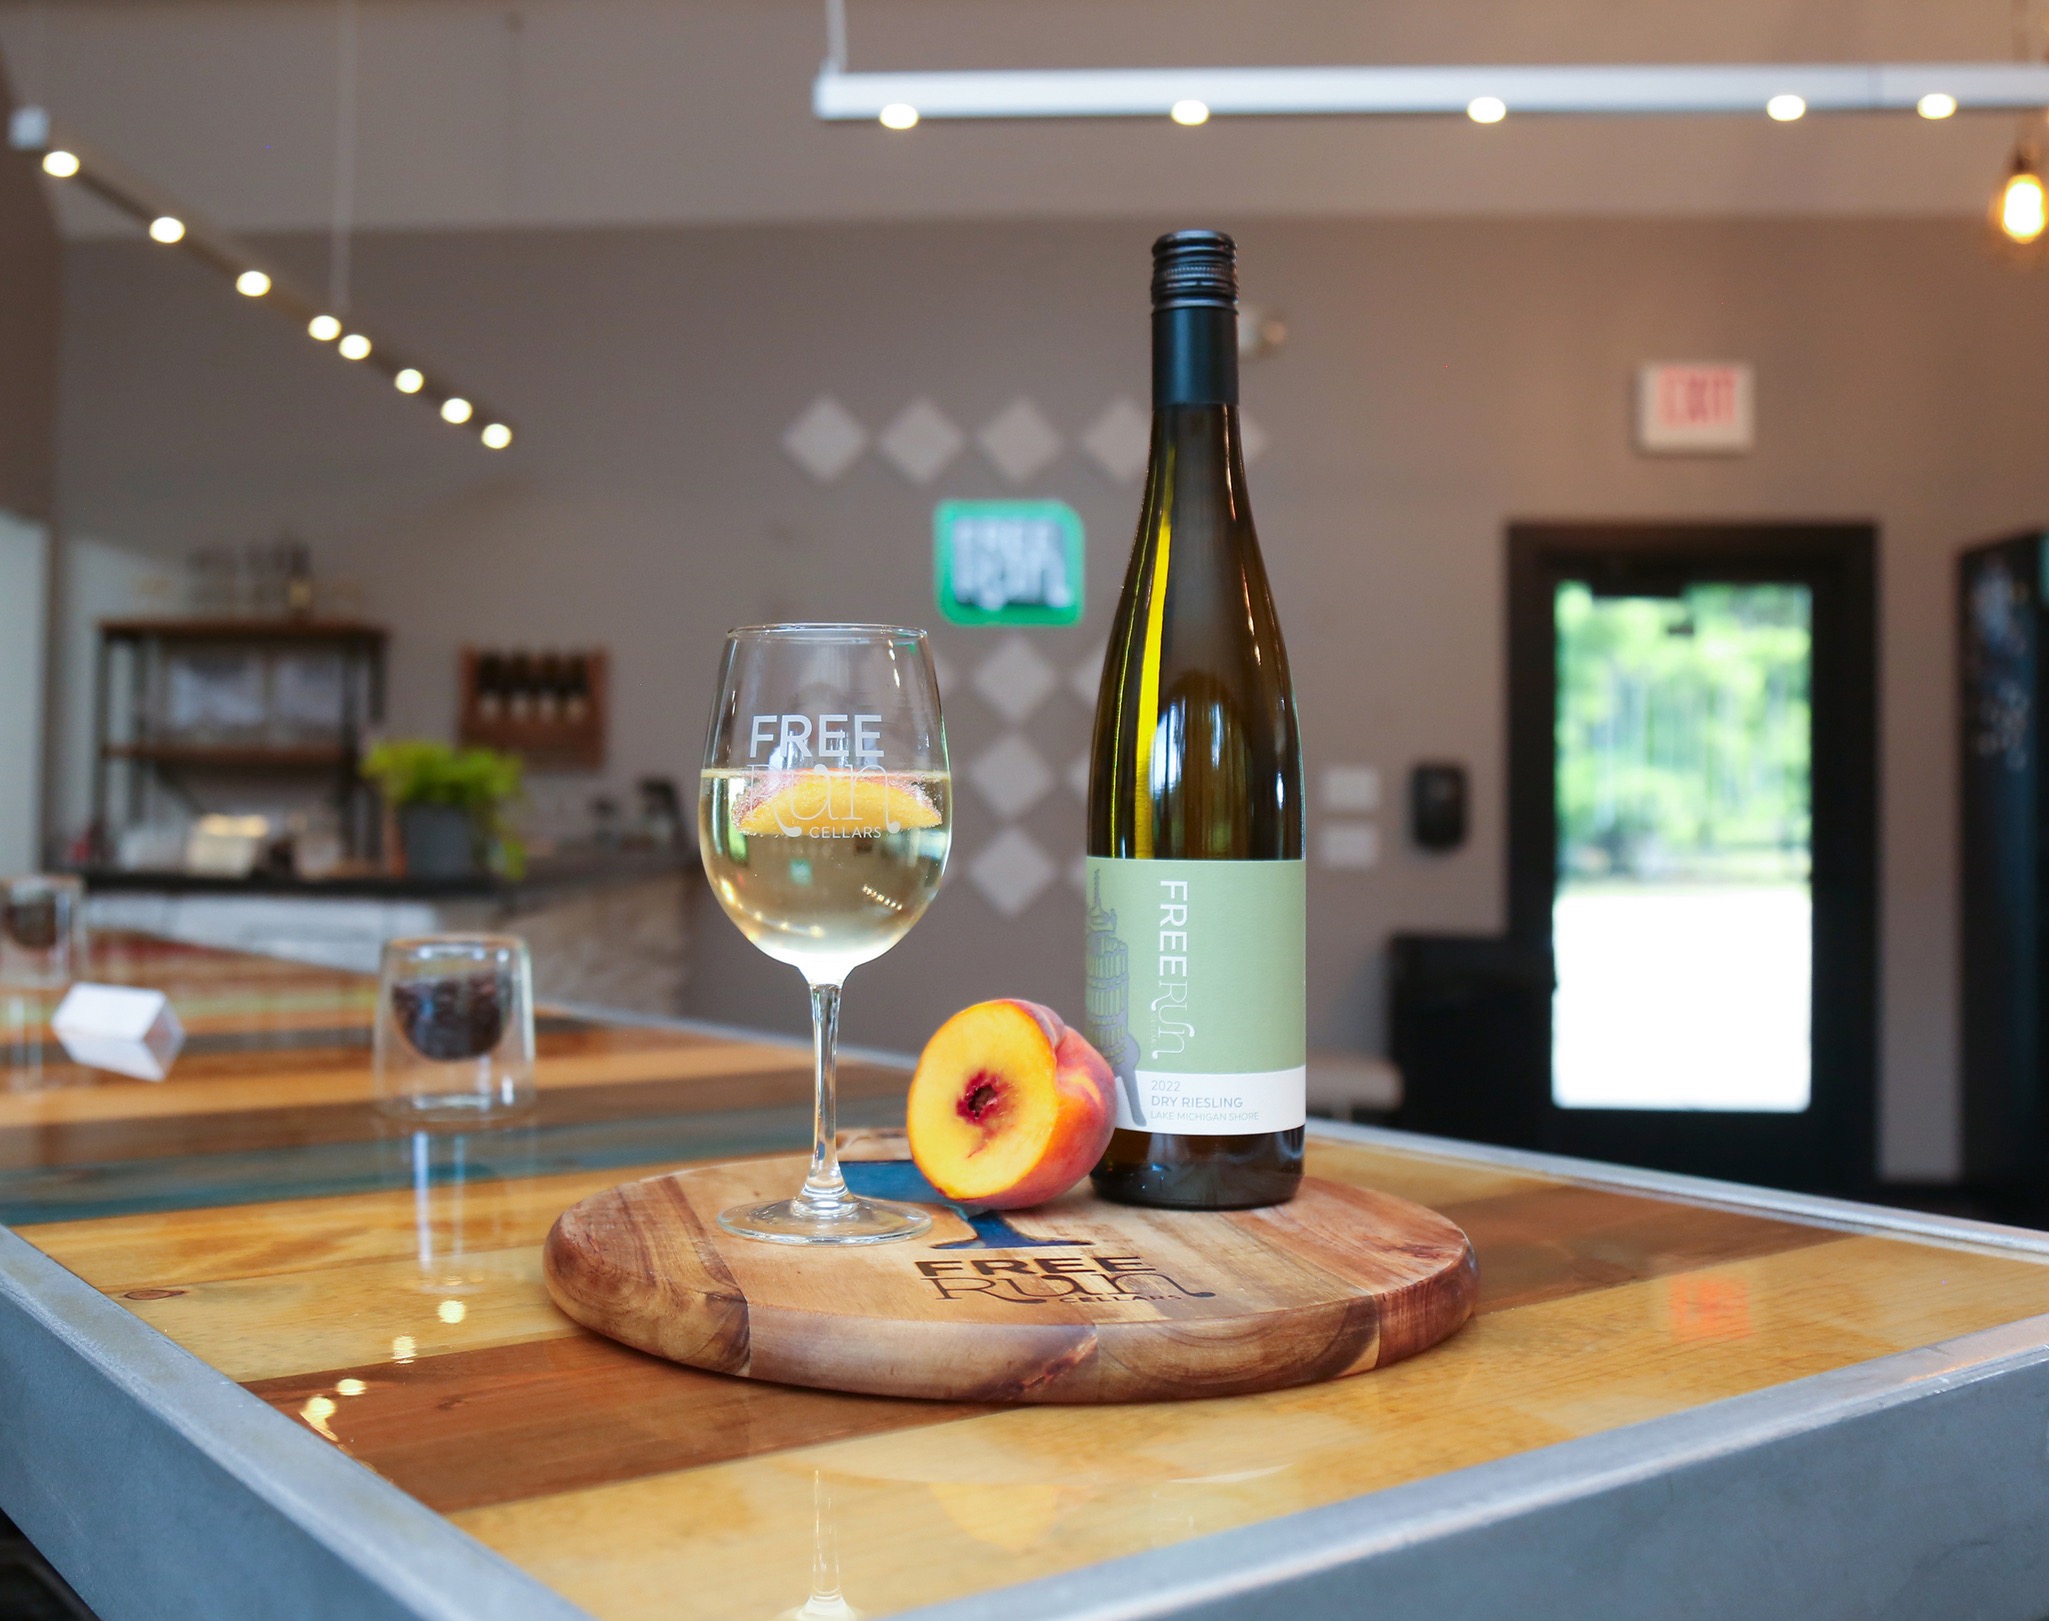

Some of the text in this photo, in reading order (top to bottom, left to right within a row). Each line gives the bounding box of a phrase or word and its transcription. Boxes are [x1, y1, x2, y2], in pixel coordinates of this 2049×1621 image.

[750, 714, 885, 758] FREE
[809, 826, 882, 839] CELLARS
[1159, 880, 1188, 977] FREE
[1151, 1080, 1181, 1092] 2022
[1151, 1095, 1243, 1109] DRY RIESLING
[1150, 1111, 1259, 1121] LAKE MICHIGAN SHORE
[913, 1256, 1157, 1277] FREE
